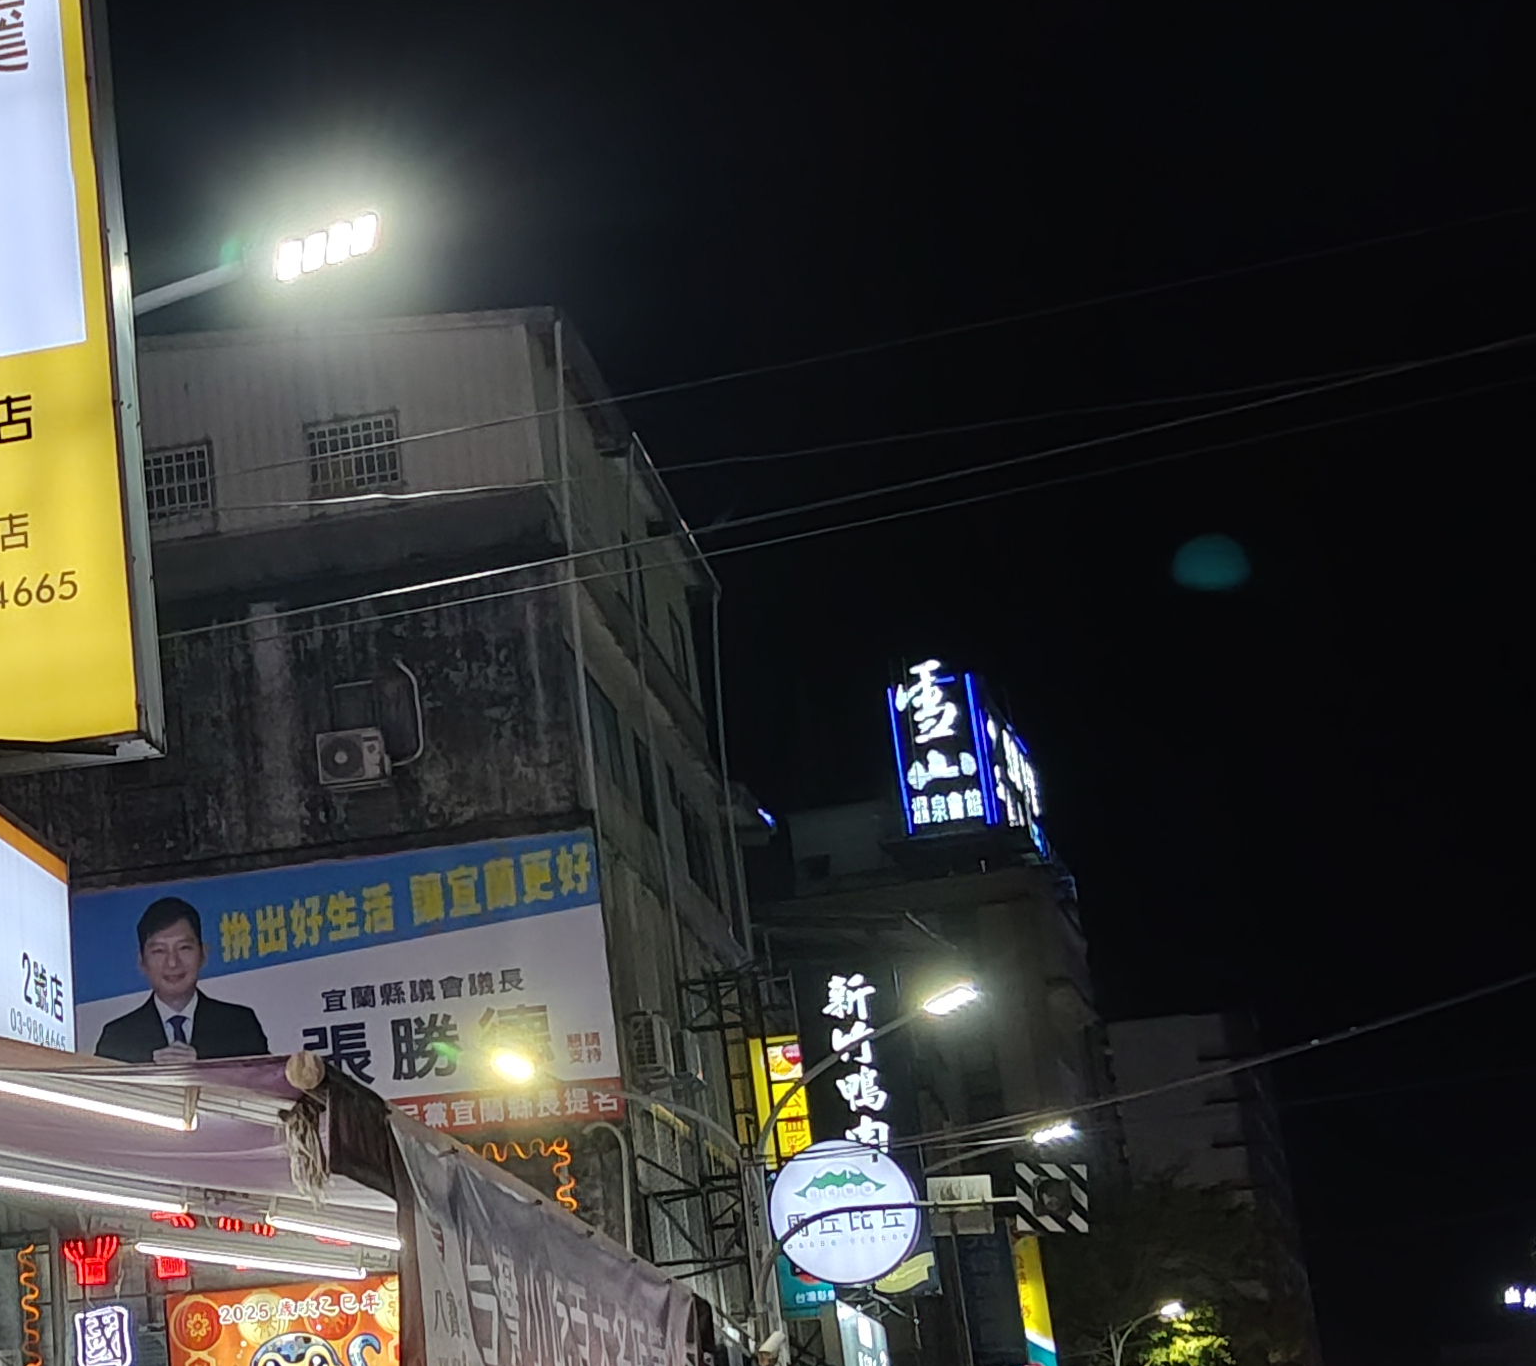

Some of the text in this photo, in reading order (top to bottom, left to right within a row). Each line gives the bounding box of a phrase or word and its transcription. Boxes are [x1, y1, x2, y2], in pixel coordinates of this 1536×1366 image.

[321, 967, 525, 1013] 宜蘭縣議會議長
[821, 973, 890, 1154] 新竹鴨肉
[218, 1303, 270, 1325] 2025
